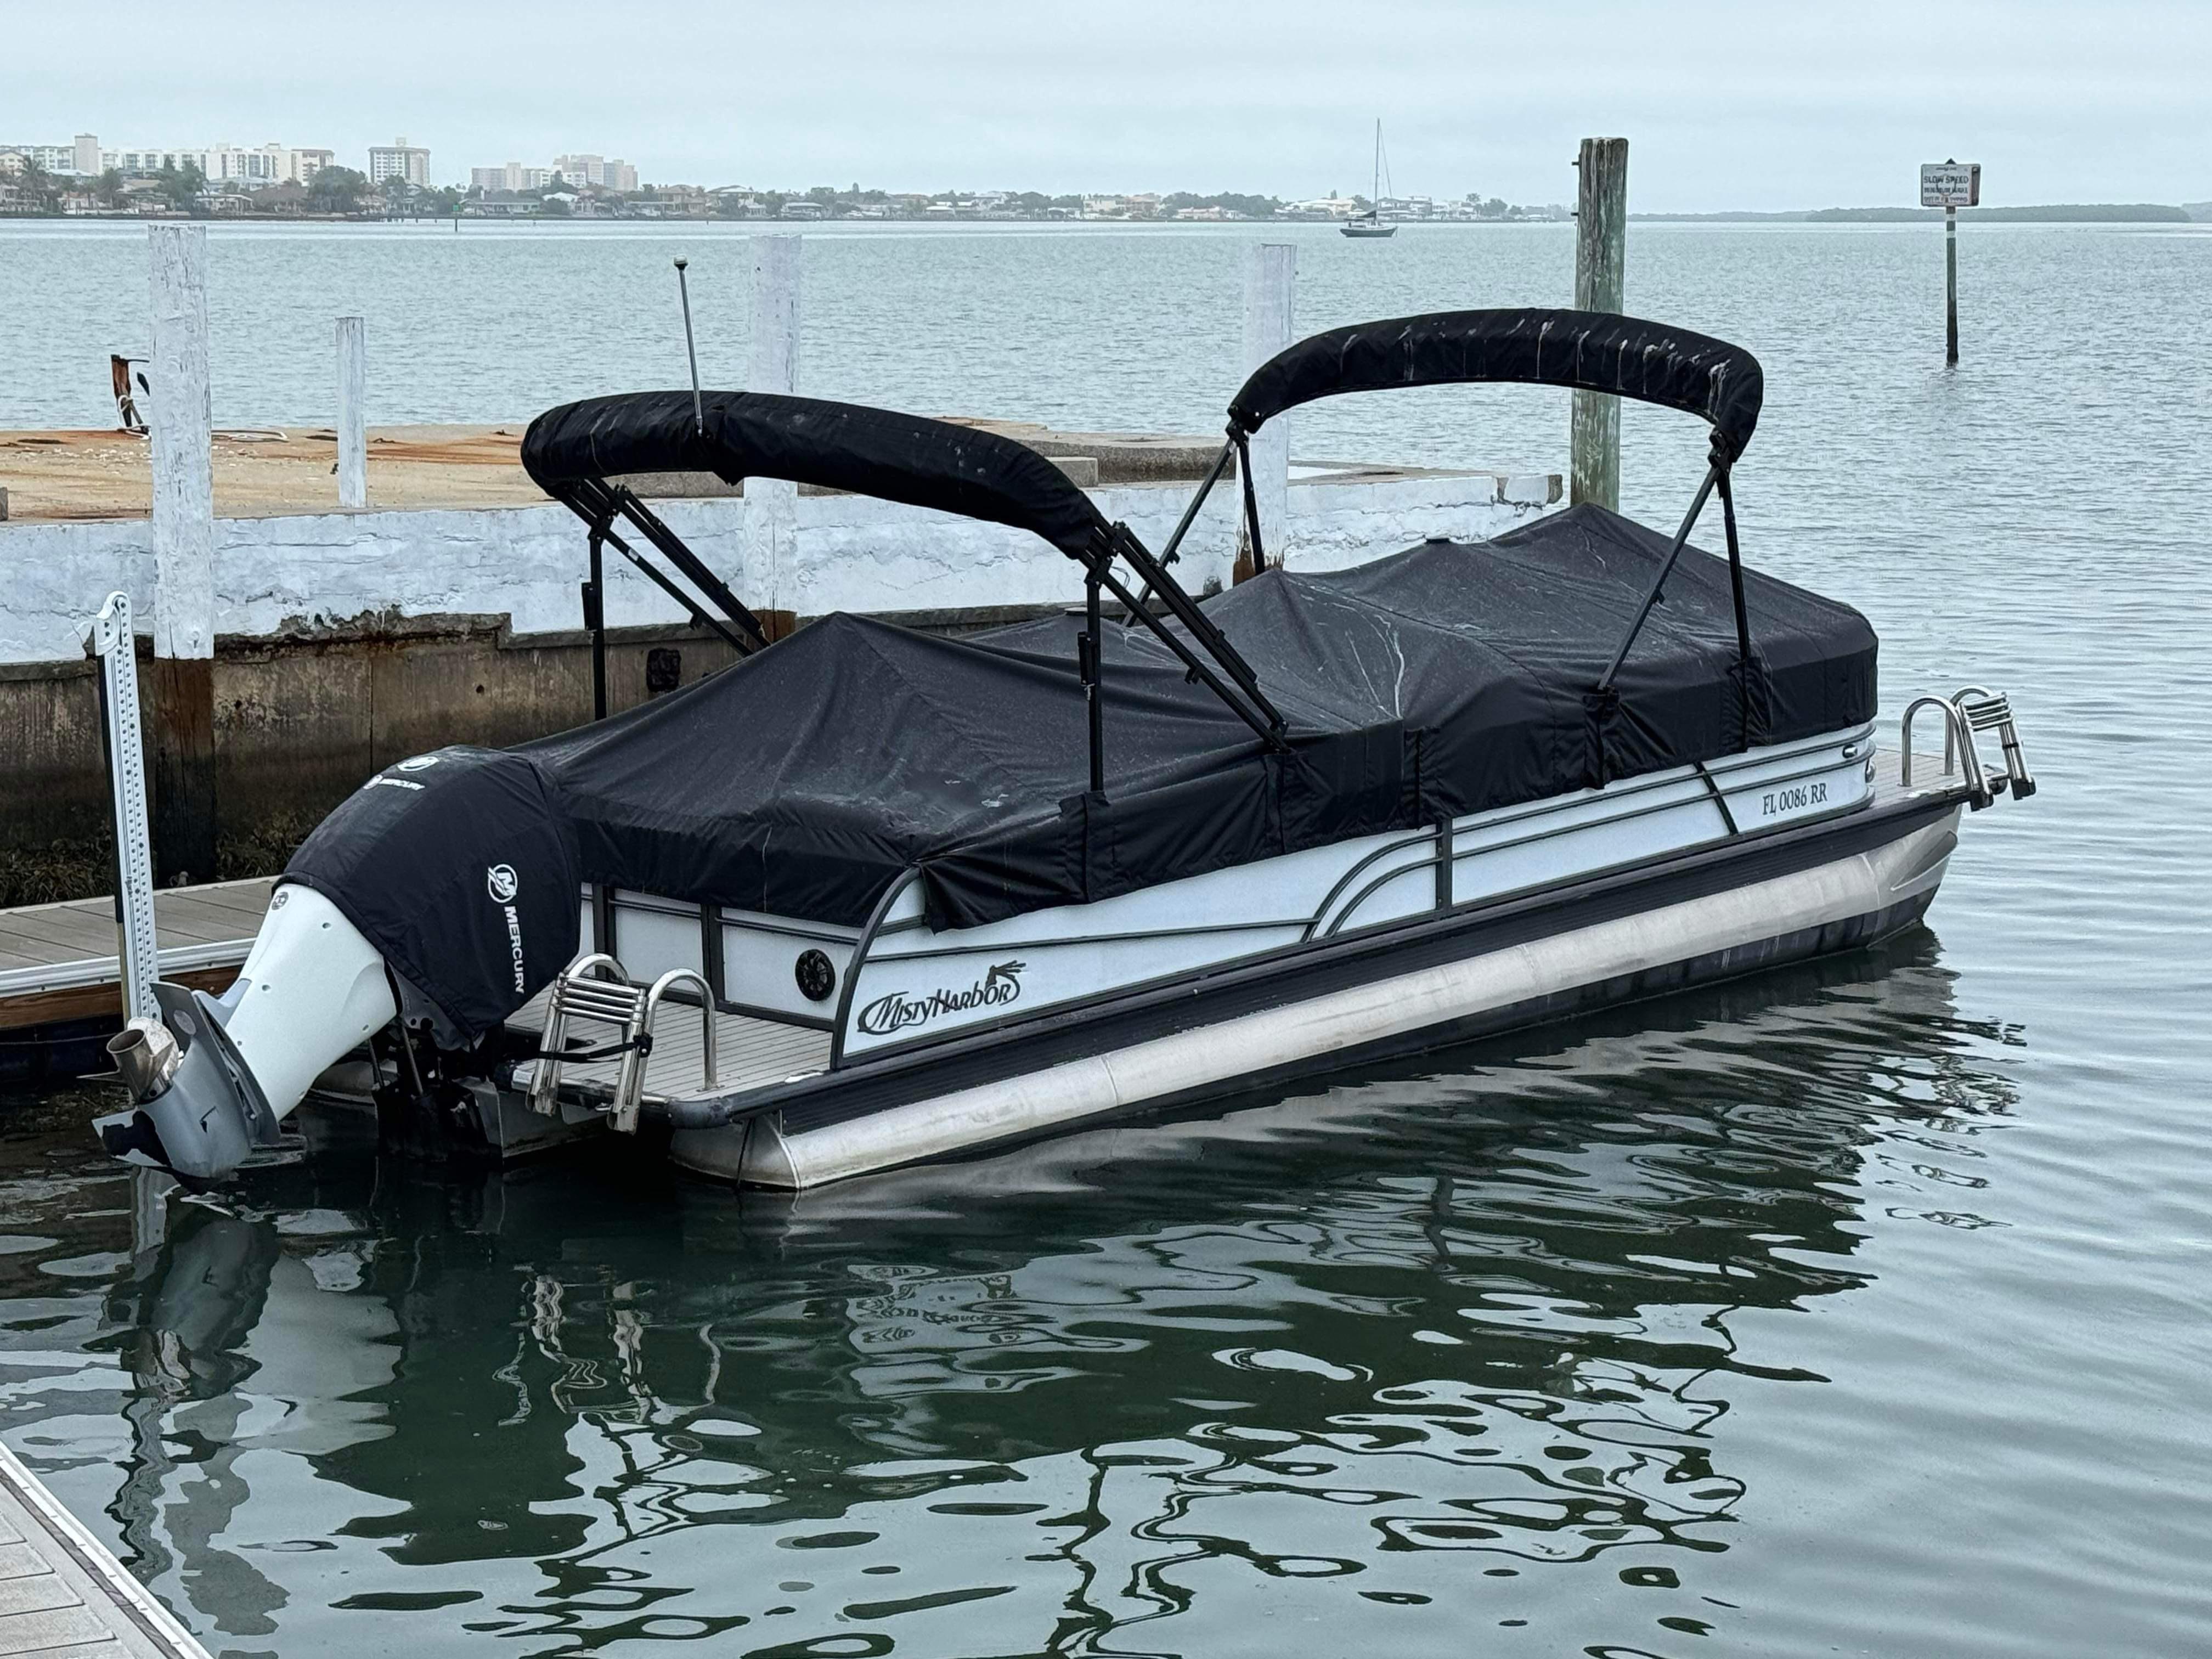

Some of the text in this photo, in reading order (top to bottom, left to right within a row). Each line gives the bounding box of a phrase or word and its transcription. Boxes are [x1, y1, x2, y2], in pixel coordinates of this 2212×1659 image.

[1945, 176, 1969, 184] SPEED
[1762, 782, 1828, 815] FL 0086 RR
[504, 905, 524, 994] MERCURY
